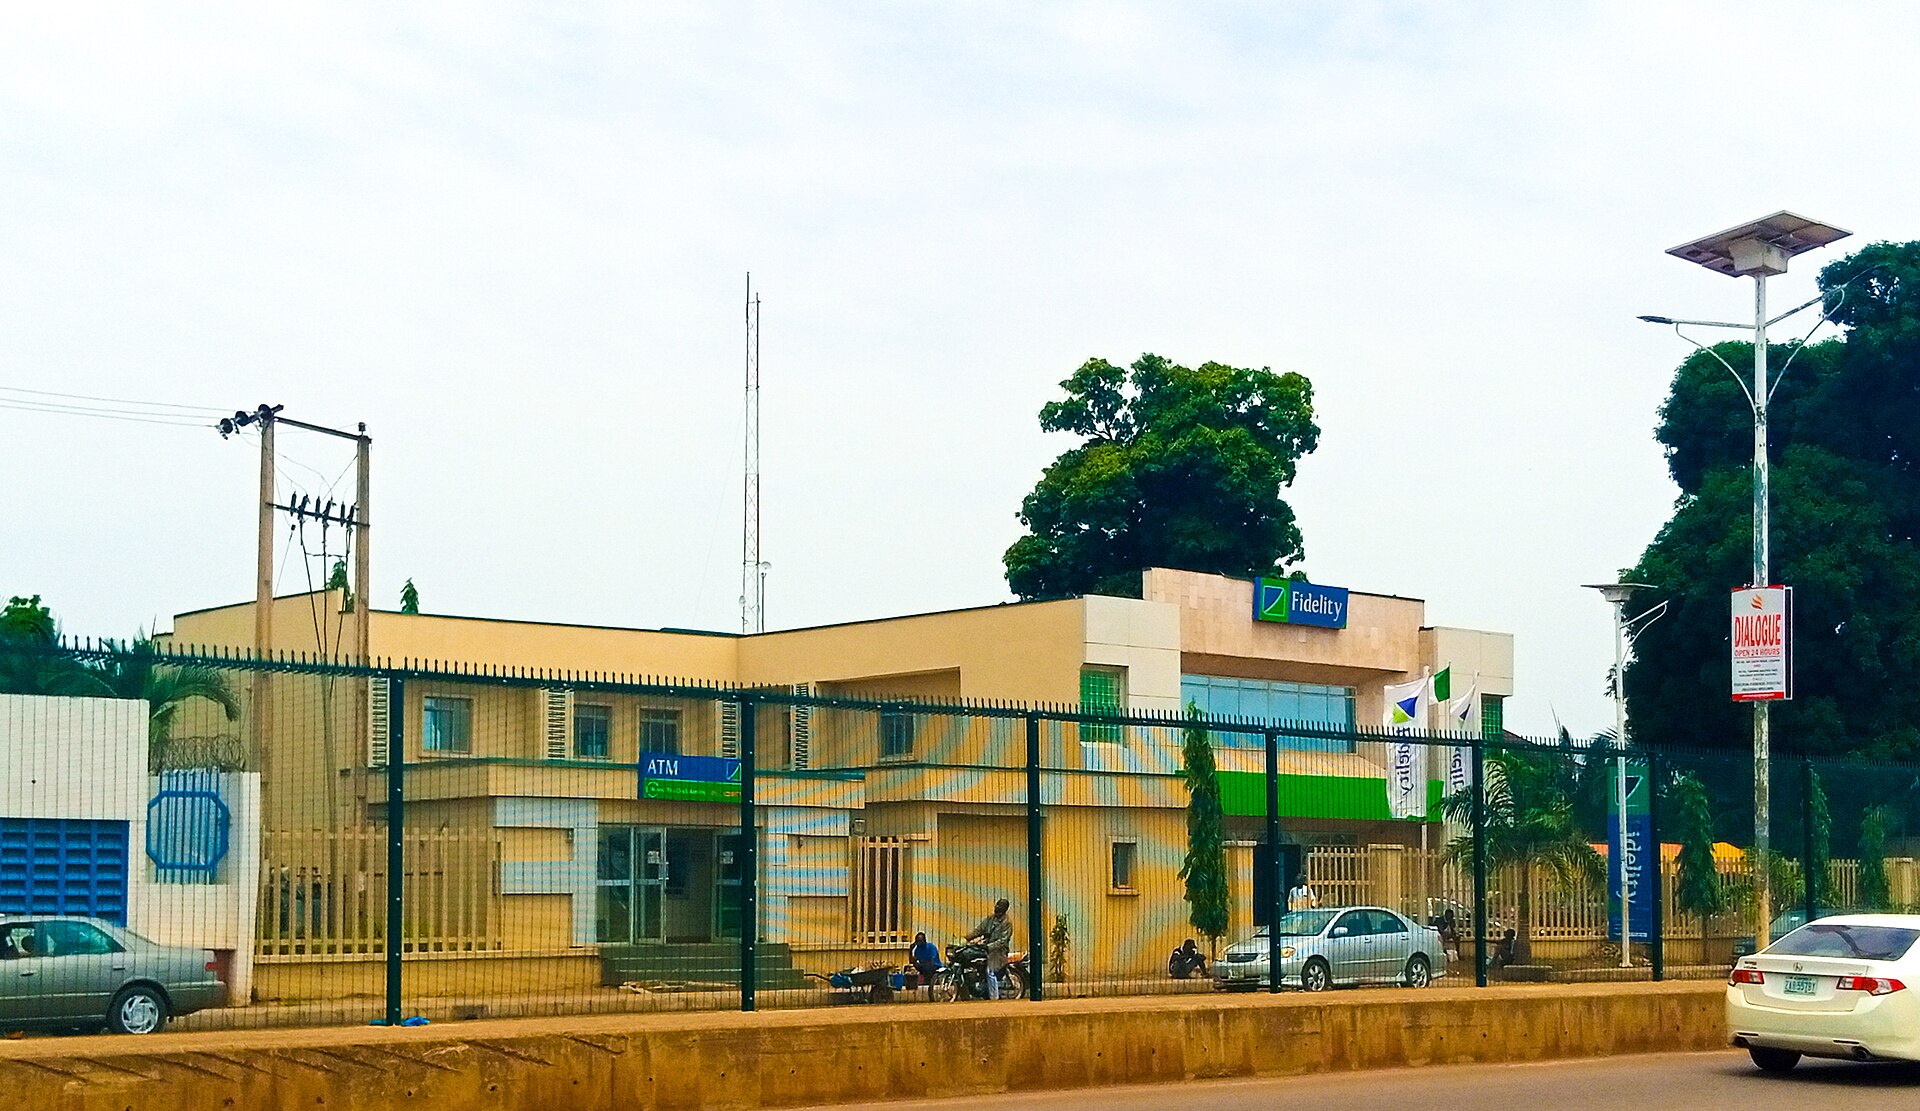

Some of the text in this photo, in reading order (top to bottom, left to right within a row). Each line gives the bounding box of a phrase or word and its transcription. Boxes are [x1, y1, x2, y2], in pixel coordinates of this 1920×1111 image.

[1291, 590, 1343, 622] Fidelity
[1734, 613, 1782, 648] DIALOGUE
[1734, 647, 1781, 657] OPEN 24 HOURS
[647, 758, 679, 776] ATM
[1615, 831, 1643, 904] idelity
